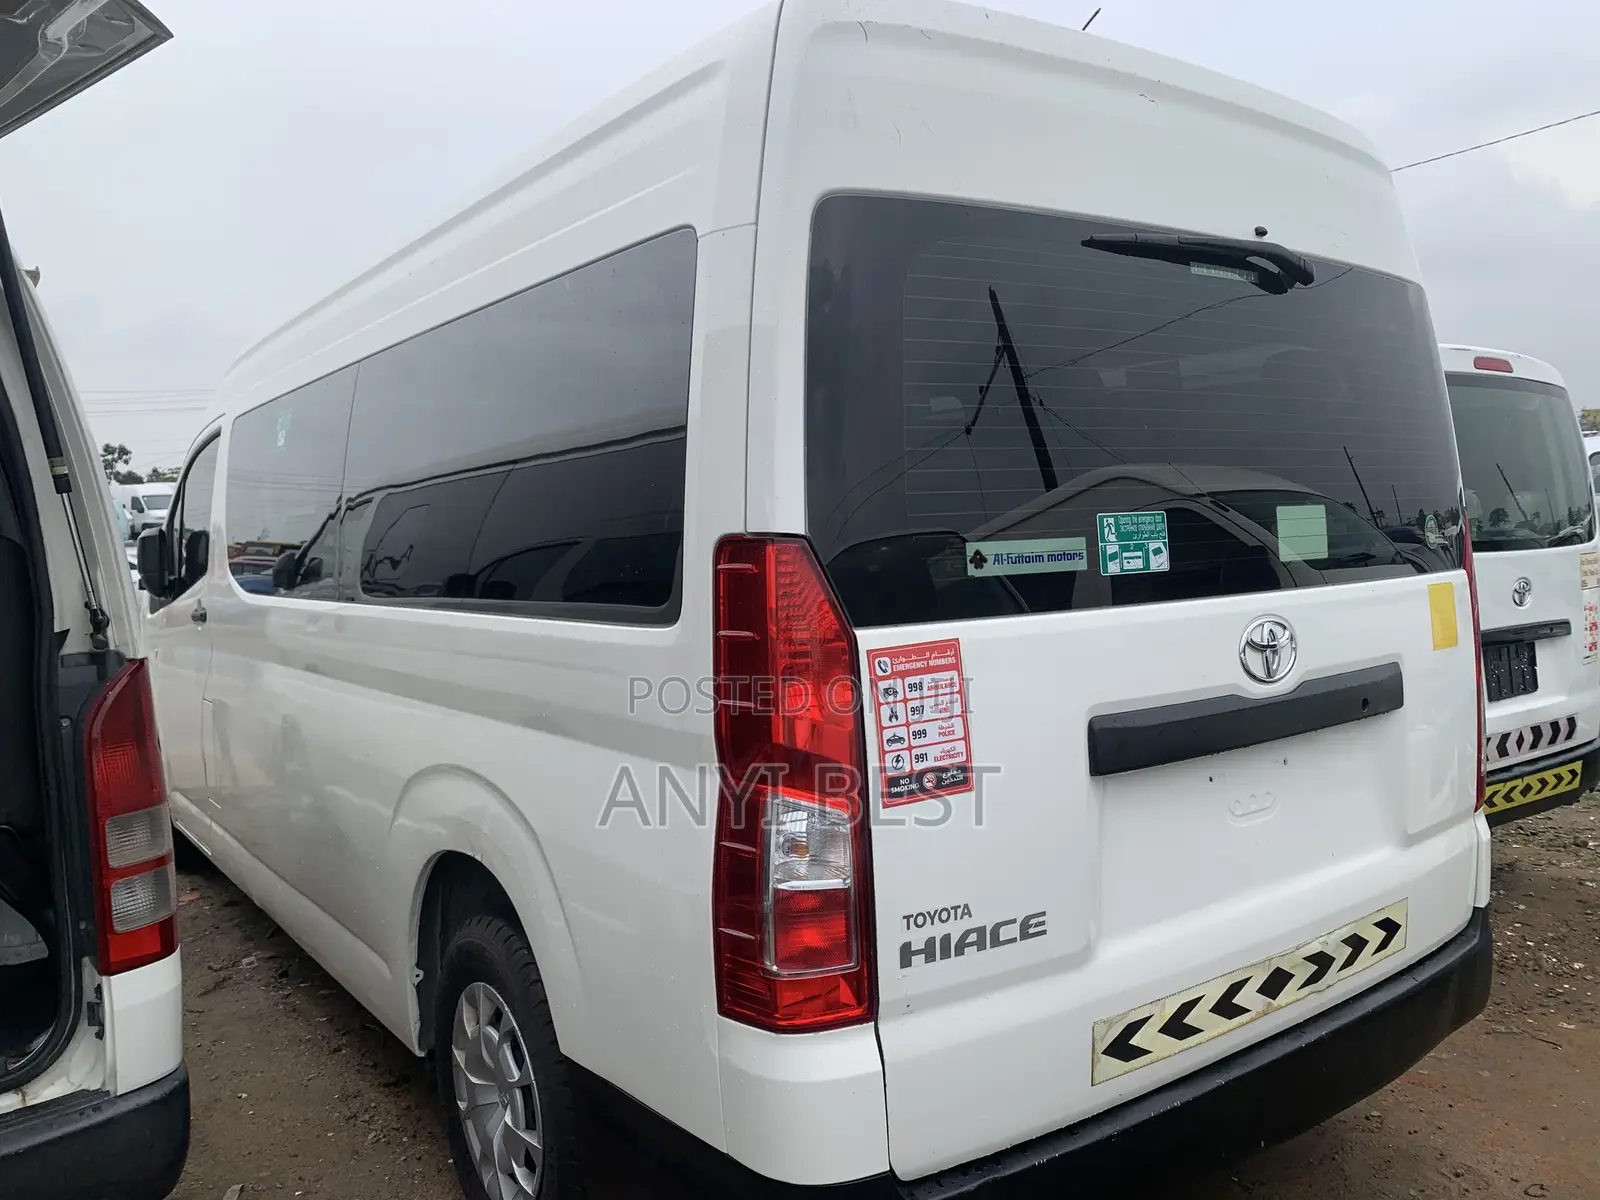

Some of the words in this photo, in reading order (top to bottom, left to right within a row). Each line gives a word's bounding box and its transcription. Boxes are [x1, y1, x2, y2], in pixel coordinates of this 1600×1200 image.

[993, 553, 1045, 566] Al-Futtaim
[1047, 551, 1084, 564] motors
[893, 660, 928, 671] EMERGENCY
[929, 656, 956, 667] NUMBERS
[908, 681, 923, 693] 998
[927, 681, 957, 691] AMBULANCE
[910, 705, 925, 716] 997
[912, 728, 927, 740] 999
[938, 729, 955, 738] POLICE
[914, 752, 928, 764] 991
[933, 751, 964, 763] ELECTRICITY
[899, 777, 910, 785] NO
[890, 782, 920, 794] SMOKING
[902, 903, 973, 931] TOYOTA
[899, 910, 1047, 970] HIACE
